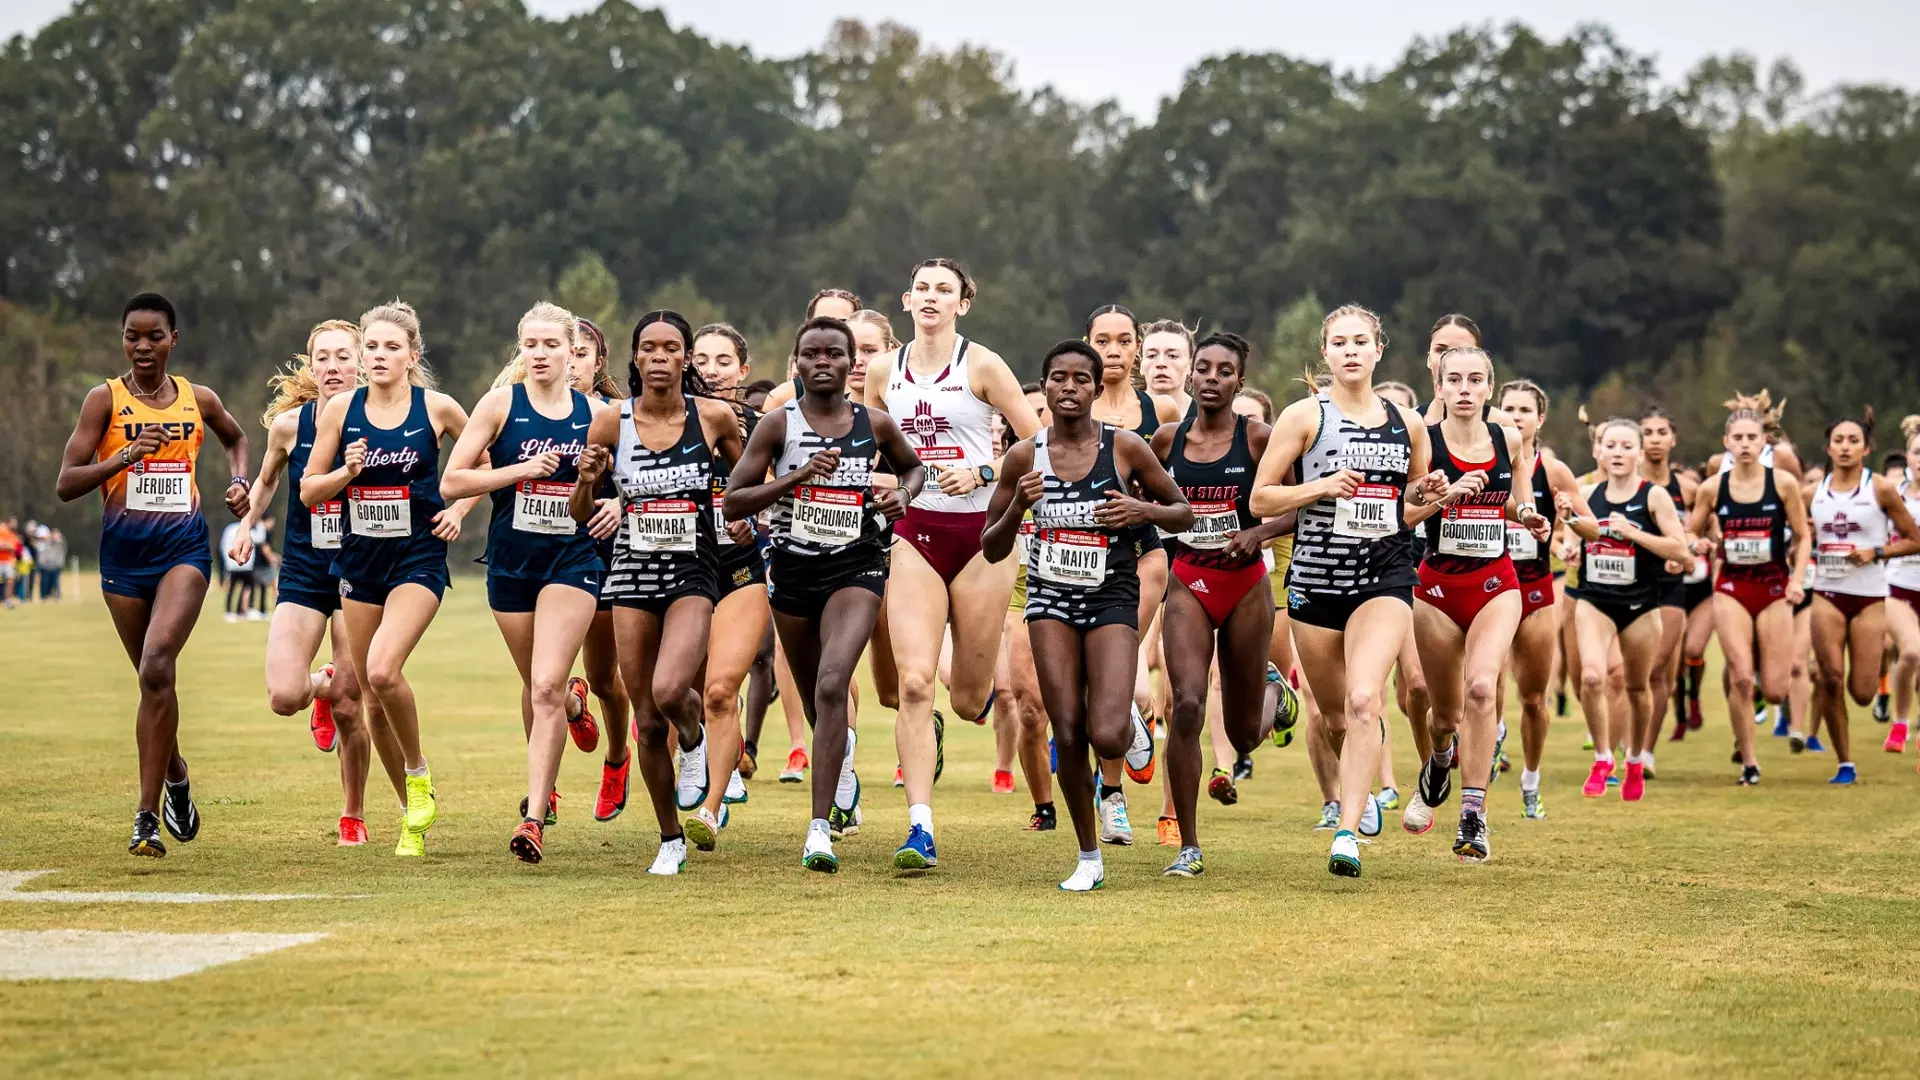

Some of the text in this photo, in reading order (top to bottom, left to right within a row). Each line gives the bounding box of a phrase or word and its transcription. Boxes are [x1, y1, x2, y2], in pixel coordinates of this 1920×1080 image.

[124, 422, 195, 441] UEP
[916, 419, 934, 427] NM
[916, 426, 935, 434] STATE
[1341, 441, 1405, 459] MIDDLE
[364, 446, 419, 473] iberty
[632, 462, 700, 485] MIDDLE
[136, 477, 184, 495] JERUBET
[1197, 485, 1239, 500] STATE
[357, 503, 400, 521] GORDON
[794, 504, 859, 530] JEPCHUMBA
[1354, 502, 1385, 521] TOWE
[637, 517, 687, 535] CHIKARA
[1442, 523, 1502, 541] CODDINGTON
[1046, 545, 1098, 570] S. MAIYO
